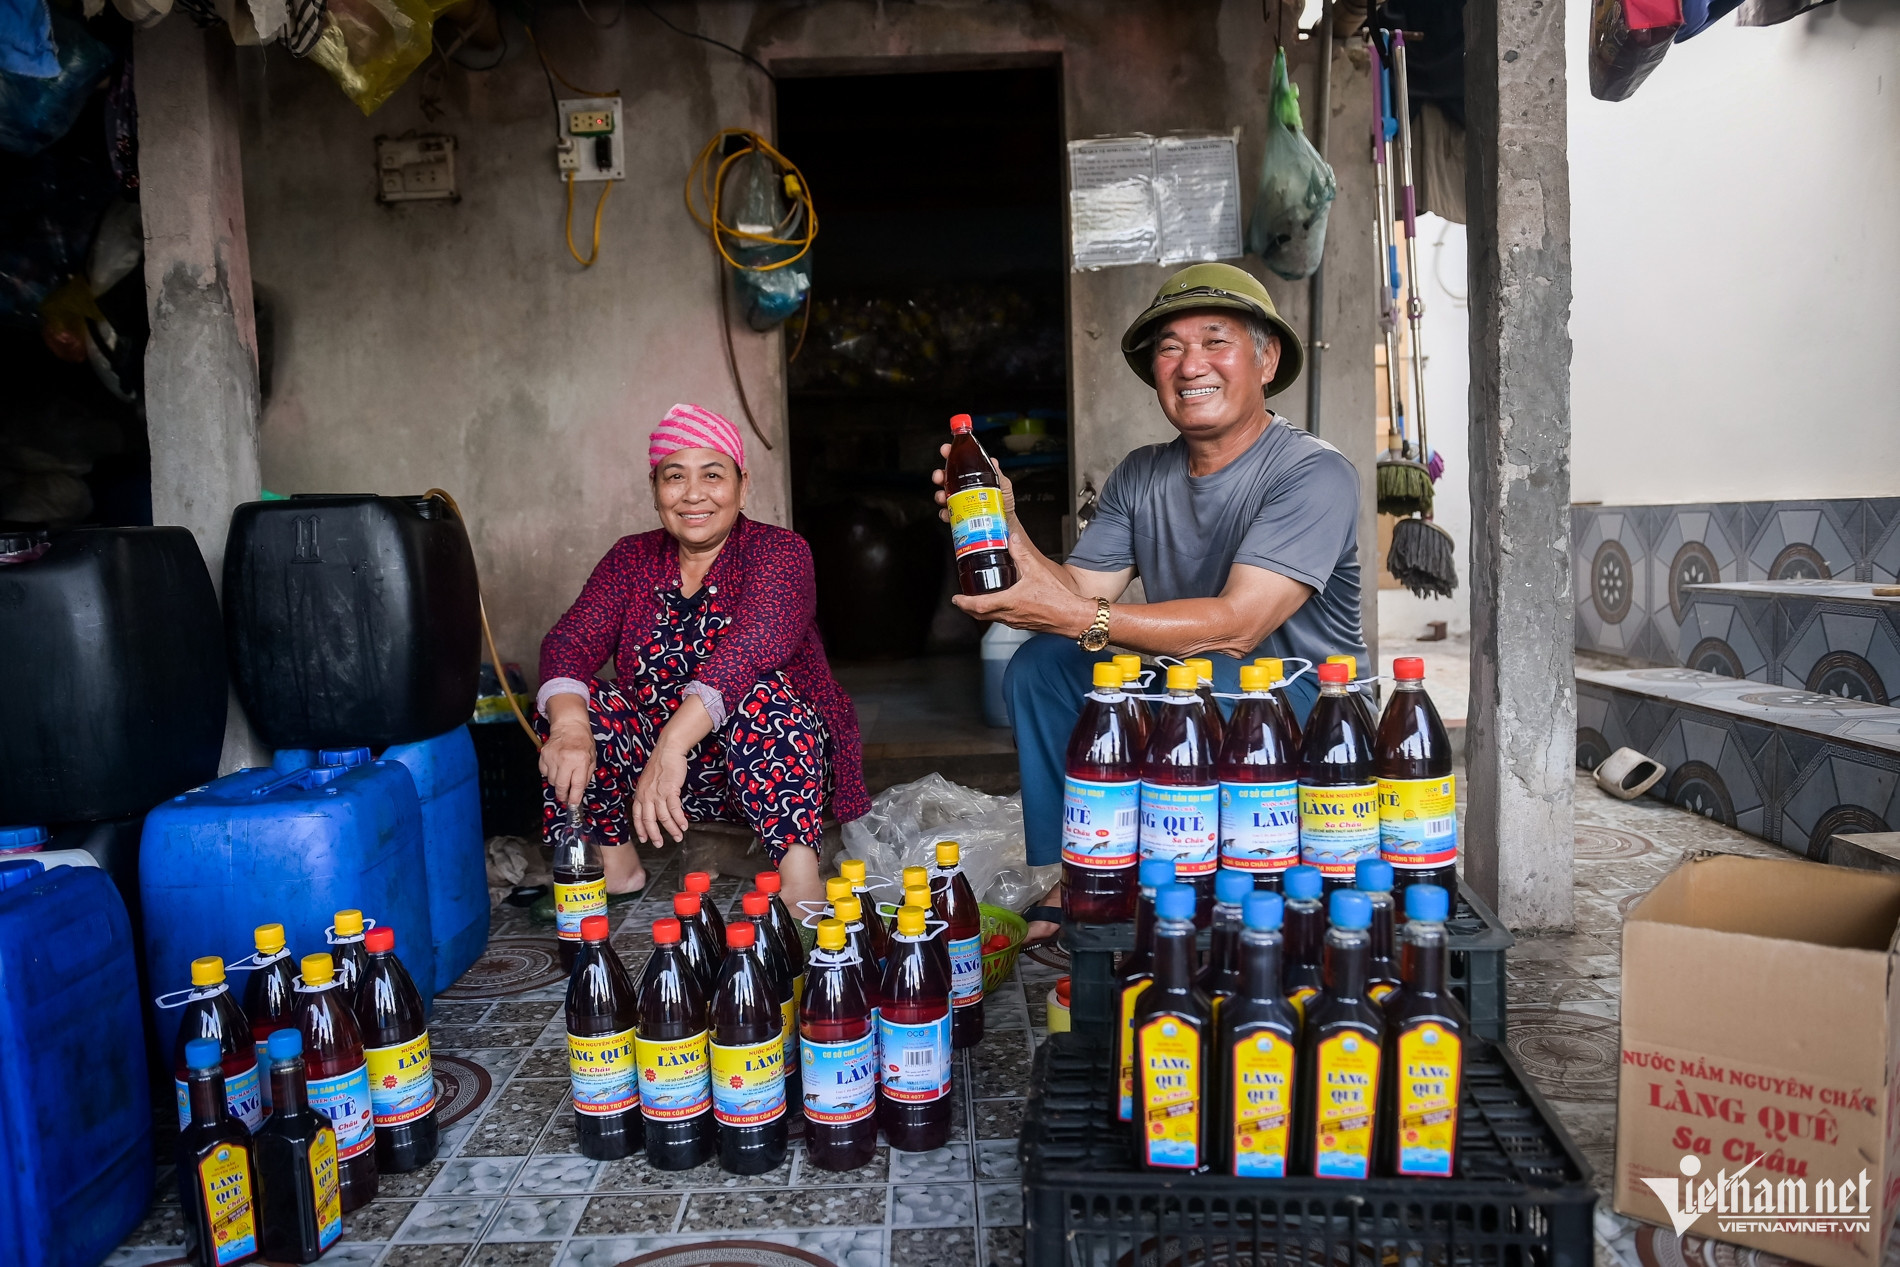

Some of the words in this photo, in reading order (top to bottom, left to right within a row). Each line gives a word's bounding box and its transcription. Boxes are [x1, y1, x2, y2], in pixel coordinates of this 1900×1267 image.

[1303, 799, 1345, 815] LÀNG
[1073, 828, 1090, 836] Châu
[1163, 812, 1204, 836] QUÊ
[565, 892, 594, 902] LÀNG
[952, 958, 979, 974] ÀNG
[569, 1044, 594, 1062] ÀNG
[601, 1041, 632, 1064] QUÊ
[658, 1049, 700, 1067] LÀNG
[746, 1050, 781, 1071] LÀNG
[1151, 1054, 1190, 1070] LÀNG
[1408, 1061, 1450, 1078] LÀNG
[1156, 1072, 1186, 1090] QUÊ
[1243, 1069, 1284, 1084] LÀNG
[1327, 1069, 1369, 1085] LÀNG
[1623, 1050, 1676, 1073] NƯỚC
[1680, 1056, 1724, 1083] MẮM
[1729, 1070, 1814, 1102] NGUYÊN
[1819, 1086, 1877, 1112] CHẤT
[1248, 1088, 1278, 1104] QUÊ
[1331, 1087, 1362, 1104] QUÊ
[1413, 1081, 1444, 1098] QUÊ
[1648, 1080, 1747, 1125] LÀNG
[1758, 1108, 1839, 1146] QUÊ
[338, 1120, 358, 1130] Châu
[1672, 1126, 1711, 1155] Sa
[1722, 1137, 1808, 1178] Châu
[315, 1155, 334, 1176] LÀNG
[210, 1172, 243, 1191] LÀNG
[216, 1184, 242, 1204] QUÊ
